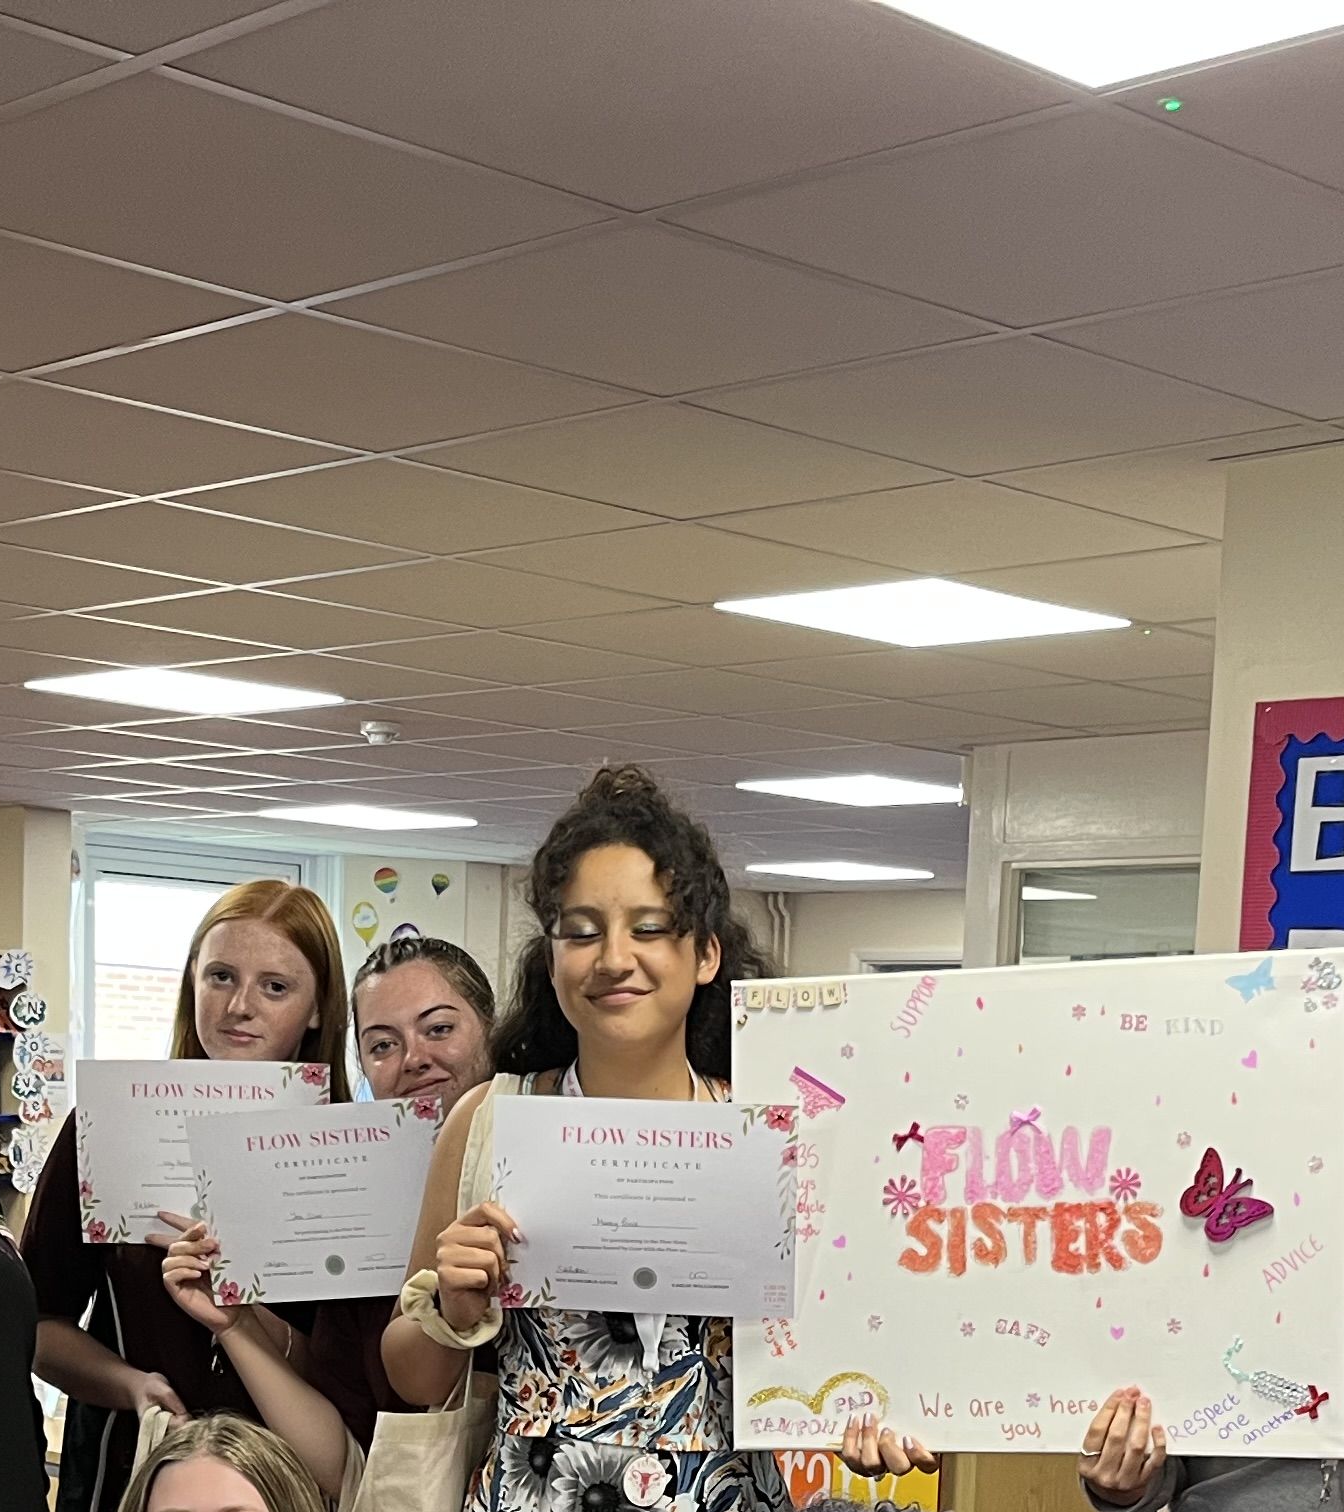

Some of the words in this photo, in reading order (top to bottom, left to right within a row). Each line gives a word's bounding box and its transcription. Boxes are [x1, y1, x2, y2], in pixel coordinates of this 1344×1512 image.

[1120, 1013, 1148, 1032] BE
[1165, 1016, 1224, 1036] KIND
[131, 1083, 184, 1099] FLOW
[193, 1083, 276, 1101] SISTERS
[246, 1132, 301, 1152] FLOW
[309, 1125, 392, 1147] SISTERS
[561, 1125, 626, 1146] FLOW
[636, 1128, 735, 1150] SISTERS
[274, 1154, 369, 1169] CERTIFICATE
[590, 1159, 702, 1170] CERTIFICATE
[919, 1124, 1114, 1204] FLOW
[897, 1199, 1164, 1278] SISTERS
[1262, 1233, 1325, 1293] ADVICE
[834, 1390, 874, 1414] PAD
[919, 1392, 954, 1418] We
[969, 1398, 1005, 1418] are
[1049, 1394, 1099, 1416] here
[1001, 1421, 1042, 1441] you
[1218, 1413, 1250, 1441] one
